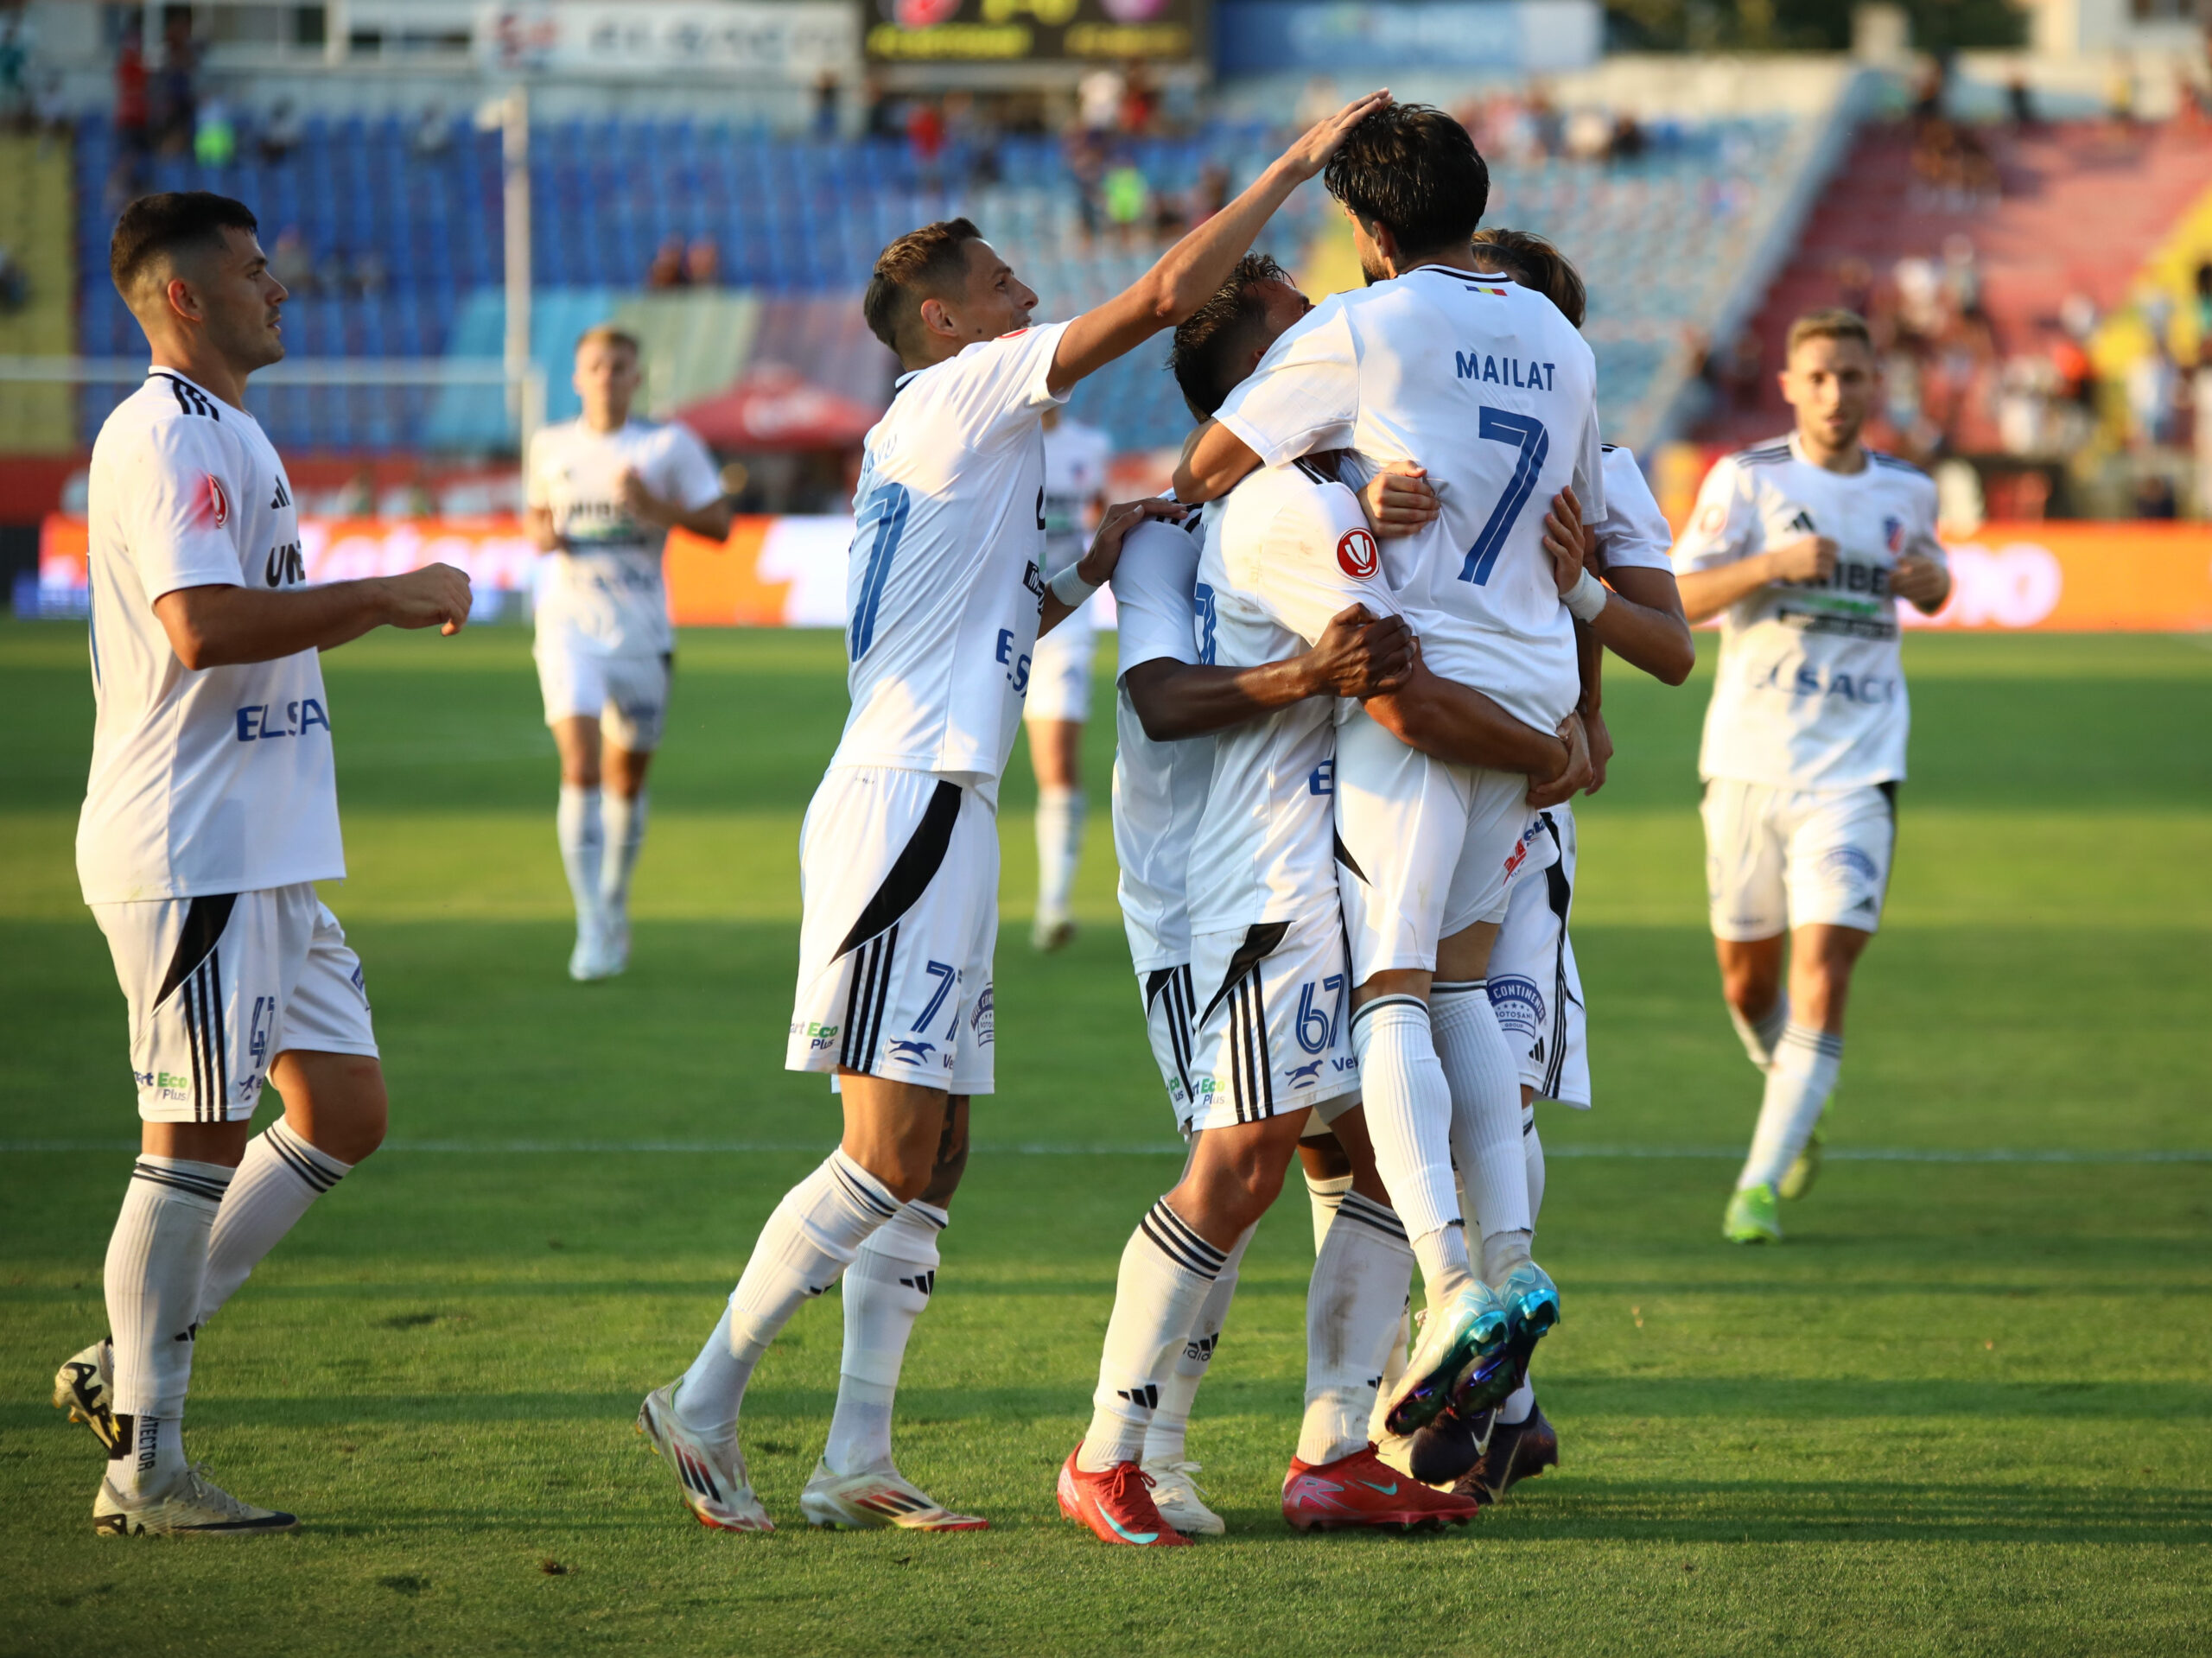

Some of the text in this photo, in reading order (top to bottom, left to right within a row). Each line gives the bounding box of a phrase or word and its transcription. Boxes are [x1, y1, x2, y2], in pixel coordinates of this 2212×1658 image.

[1456, 351, 1555, 391] MAILAT
[1458, 405, 1549, 587] 7
[1295, 973, 1345, 1055] 67
[807, 1022, 839, 1038] Eco
[810, 1039, 835, 1051] Plus
[157, 1072, 188, 1089] Eco
[1200, 1078, 1226, 1094] Eco
[162, 1089, 188, 1101] Plus
[1203, 1094, 1225, 1106] Plus
